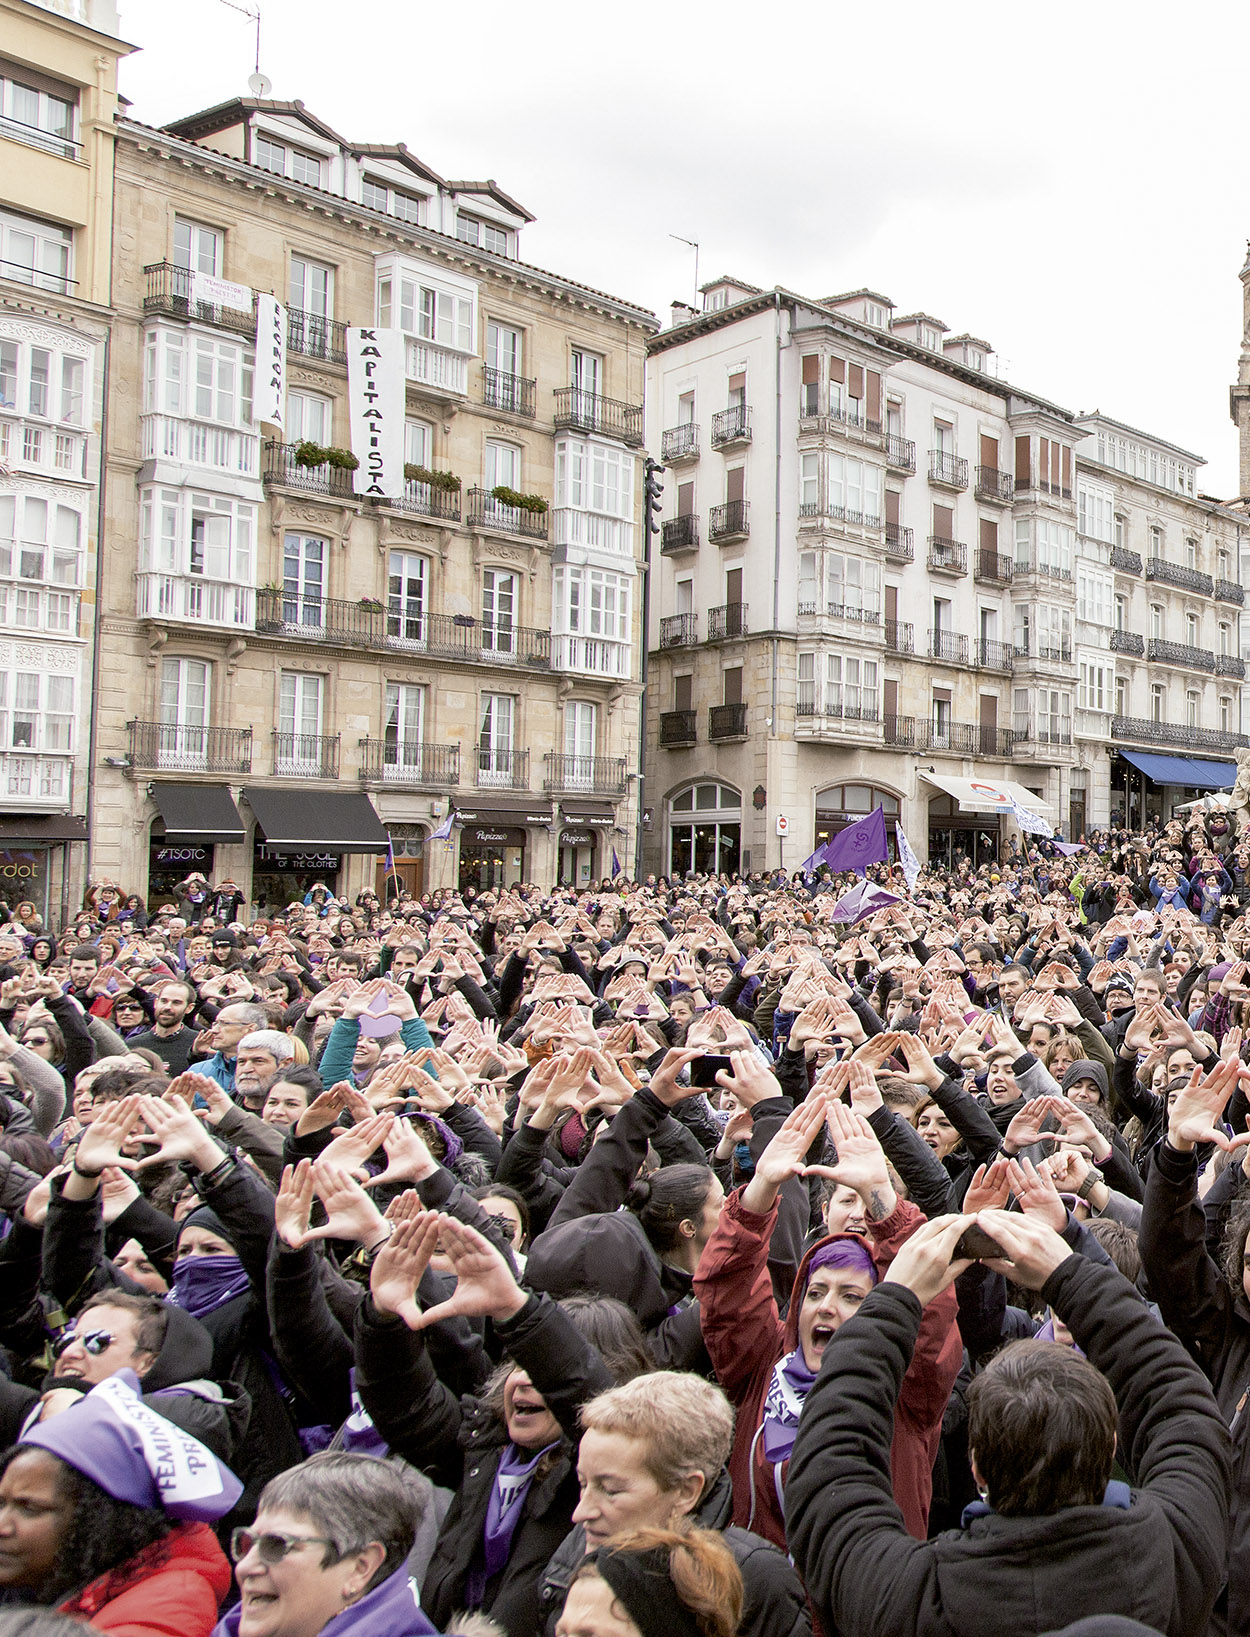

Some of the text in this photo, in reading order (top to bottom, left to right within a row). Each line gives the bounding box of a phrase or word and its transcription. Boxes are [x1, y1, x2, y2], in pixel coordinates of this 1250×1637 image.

[360, 329, 385, 495] KAPITALISTA
[157, 848, 206, 860] #TSOTC
[106, 1382, 177, 1490] FEMINIST
